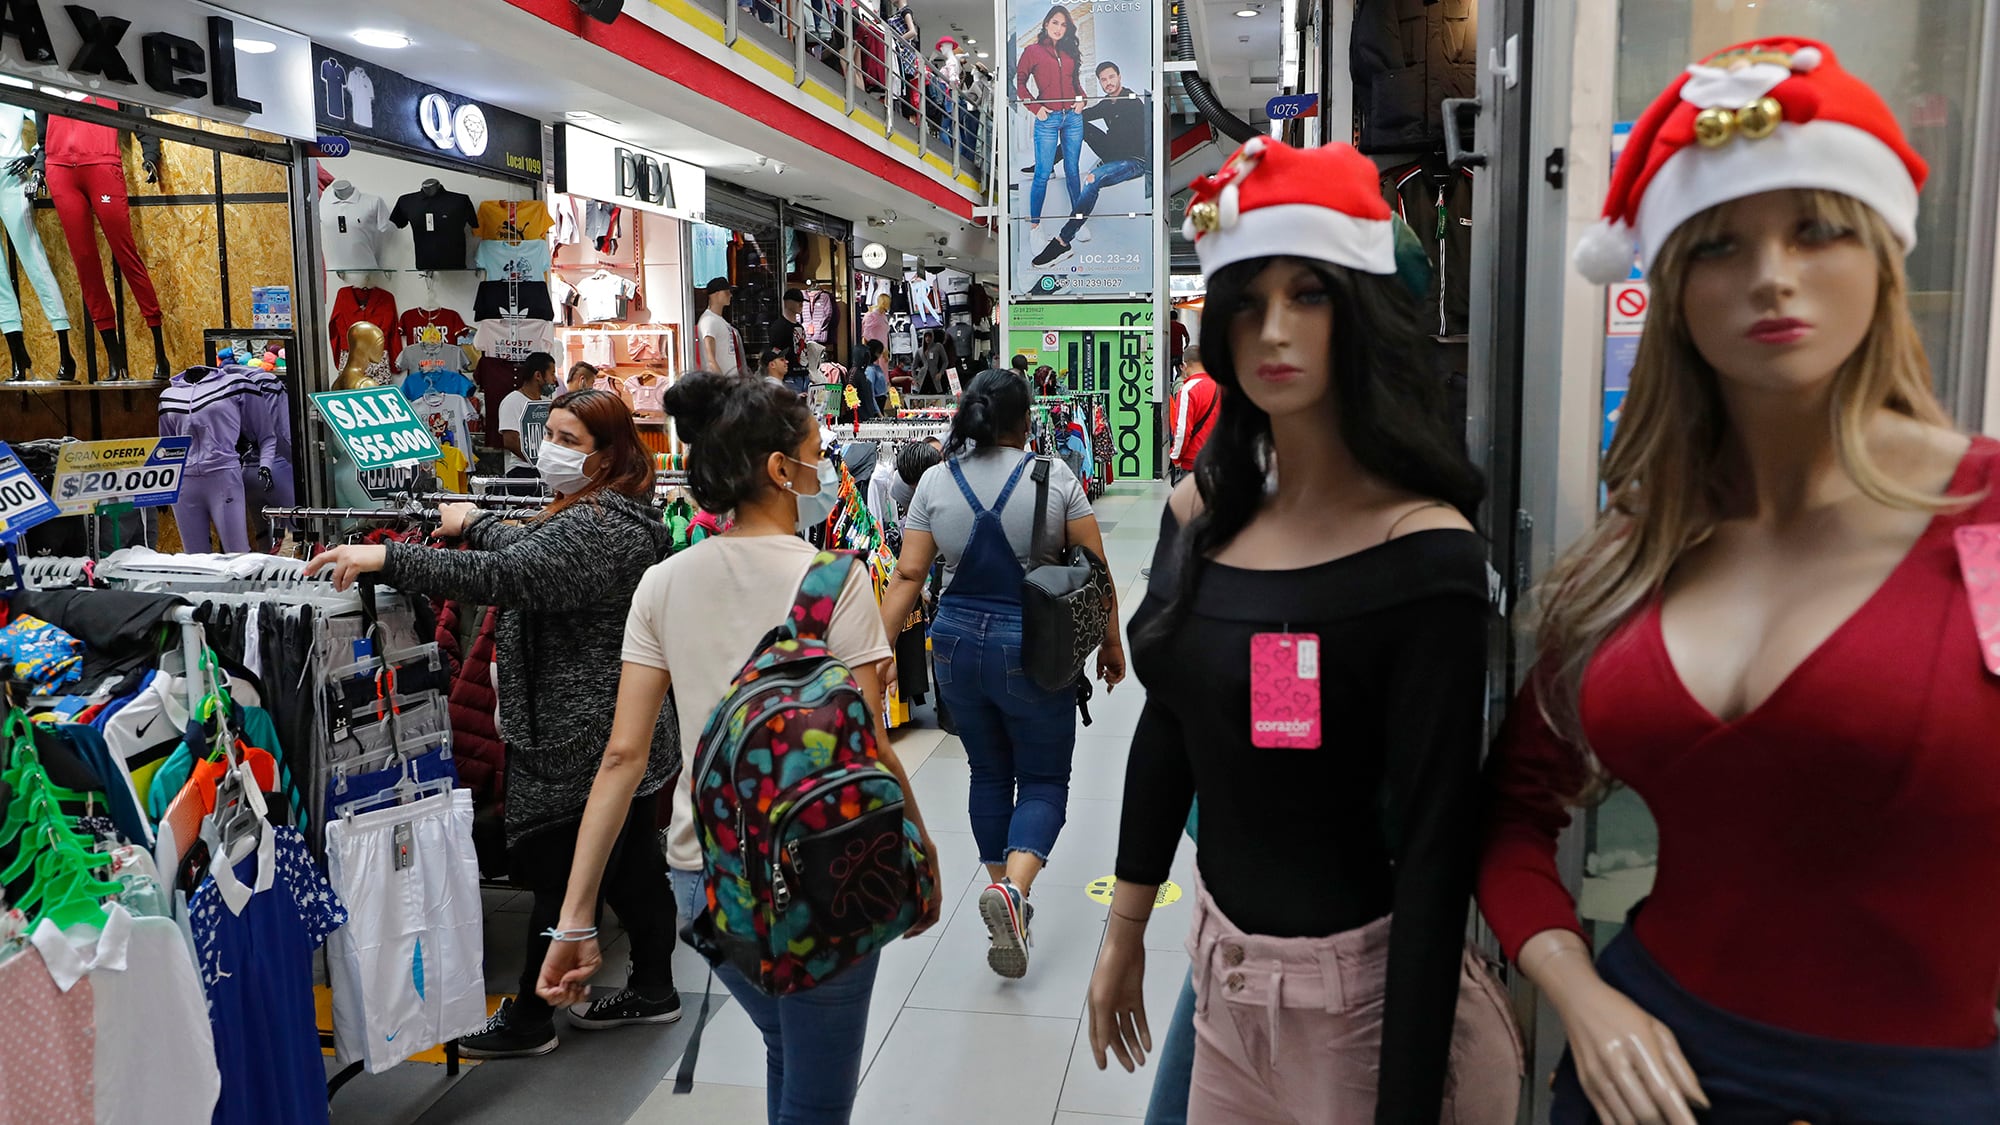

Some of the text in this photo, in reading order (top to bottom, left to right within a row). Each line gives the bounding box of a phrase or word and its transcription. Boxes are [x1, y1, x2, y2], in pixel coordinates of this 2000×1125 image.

[1089, 2, 1141, 13] JACKETS
[1273, 104, 1299, 116] 1075
[320, 143, 344, 155] 1099
[506, 152, 542, 174] Local 1099
[1080, 254, 1140, 264] LOC. 23-24
[1073, 279, 1084, 288] 311
[1086, 279, 1102, 288] 239
[1104, 279, 1122, 288] 1627
[1119, 311, 1142, 477] DOUGGER
[327, 392, 412, 430] SALE
[348, 428, 432, 463] $55.000
[64, 447, 146, 463] GRAN OFERTA
[1255, 717, 1311, 732] corazón
